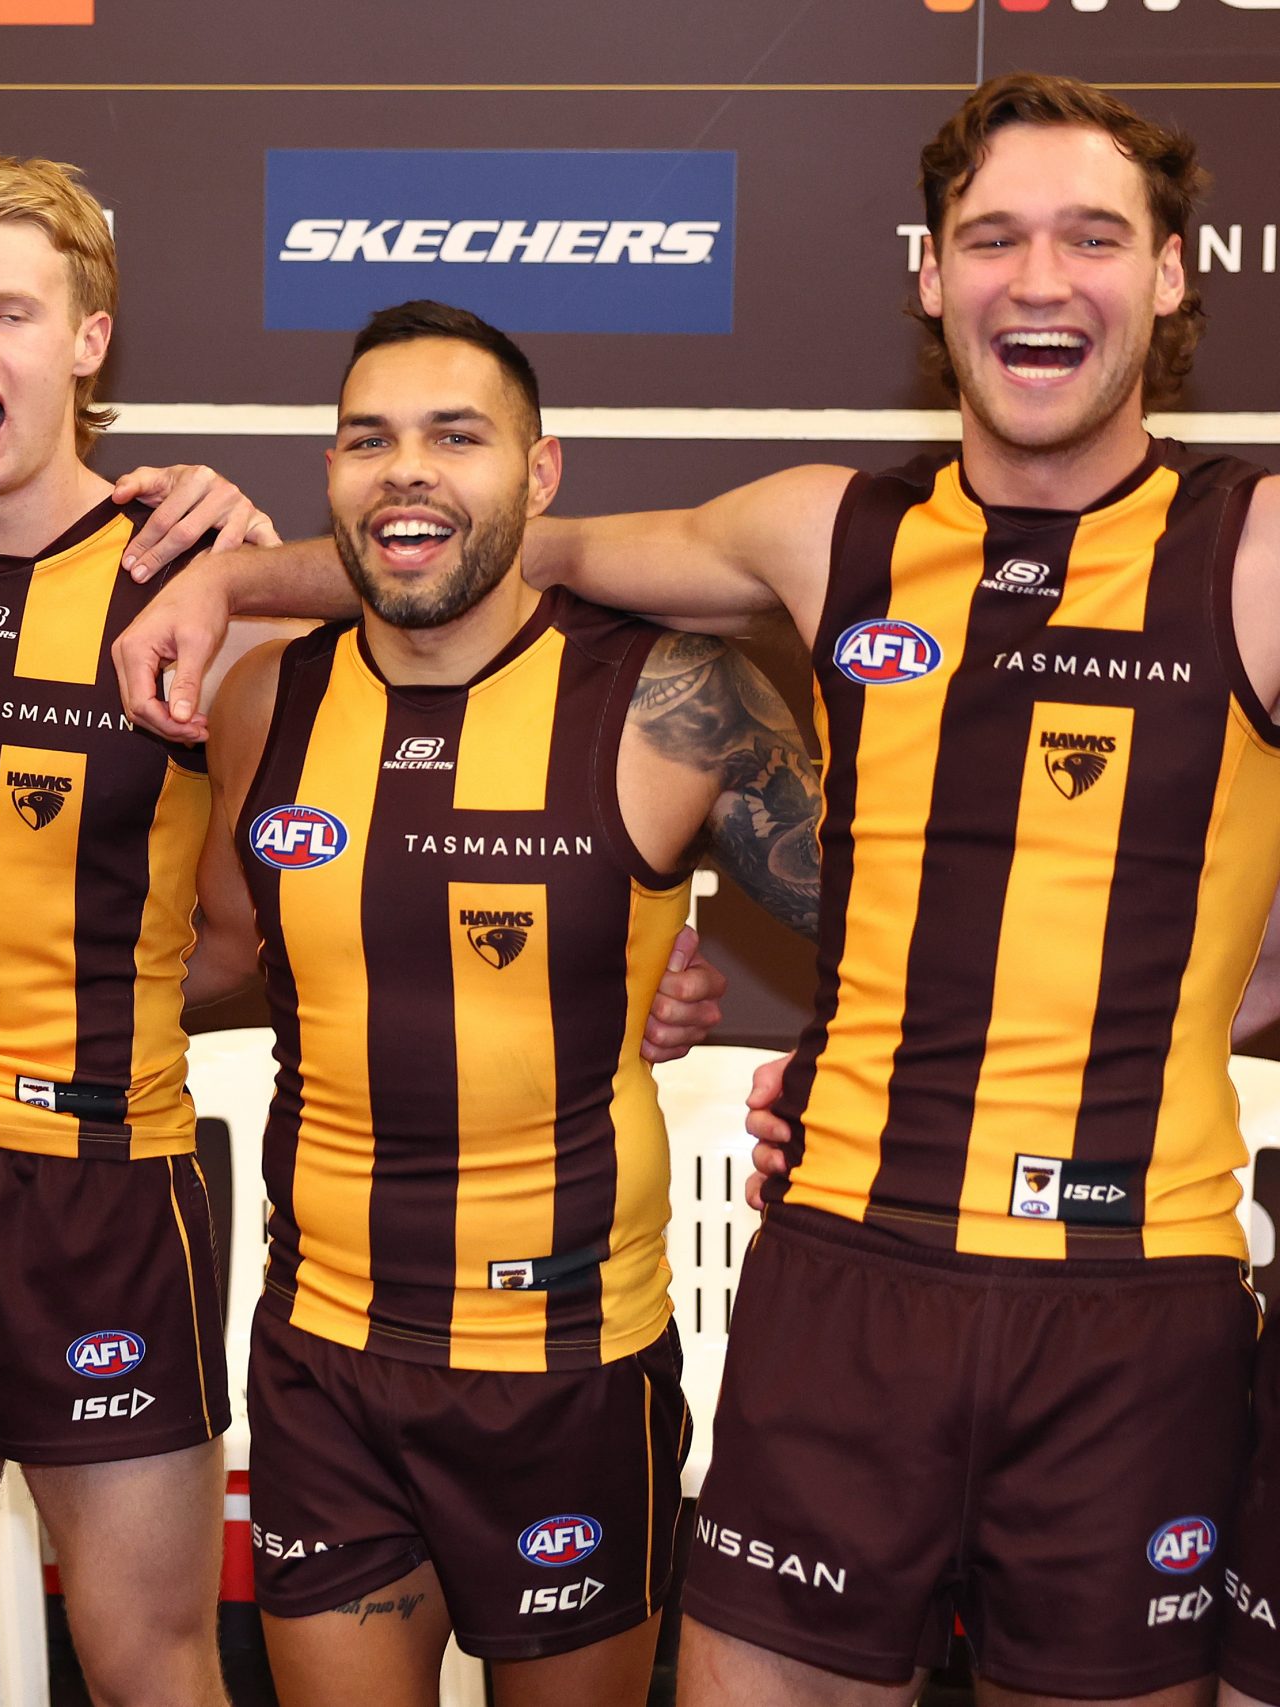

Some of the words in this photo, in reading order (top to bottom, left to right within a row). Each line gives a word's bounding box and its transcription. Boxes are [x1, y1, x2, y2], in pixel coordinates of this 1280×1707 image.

[278, 219, 720, 264] SKECHERS
[839, 634, 928, 673] AFL
[1040, 731, 1116, 753] HAWKS
[382, 760, 455, 771] SKECHERS
[7, 771, 72, 794] HAWKS
[255, 821, 335, 854] AFL
[404, 834, 593, 855] TASMANIAN
[460, 909, 533, 927] HAWKS
[1063, 1183, 1108, 1201] ISC
[75, 1340, 139, 1368] AFL
[72, 1393, 130, 1421] ISC
[527, 1525, 595, 1555] AFL
[696, 1515, 846, 1594] NISSAN
[1154, 1528, 1211, 1562] AFL
[519, 1582, 581, 1614] ISC
[1147, 1592, 1198, 1627] ISC
